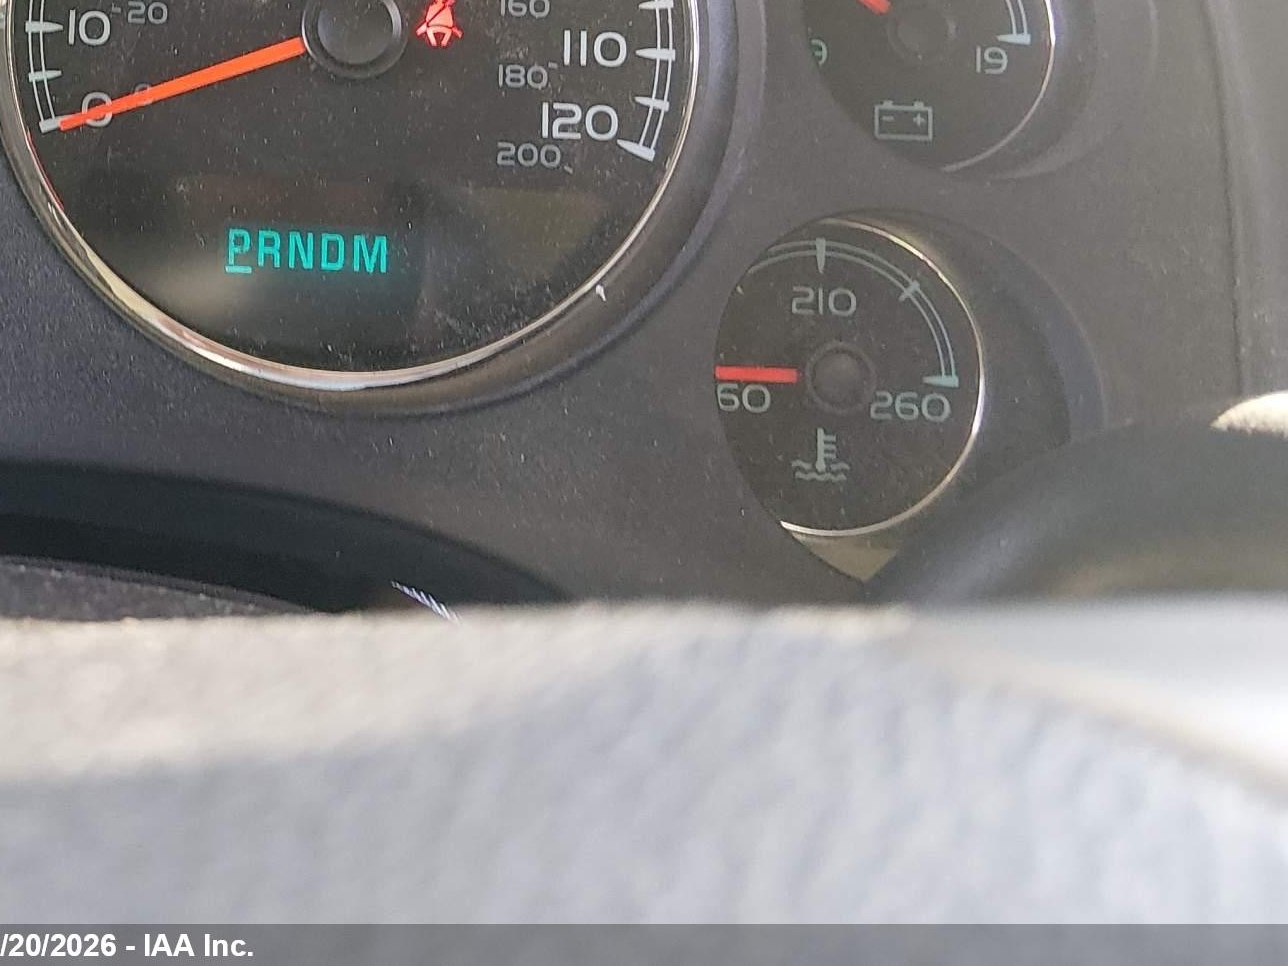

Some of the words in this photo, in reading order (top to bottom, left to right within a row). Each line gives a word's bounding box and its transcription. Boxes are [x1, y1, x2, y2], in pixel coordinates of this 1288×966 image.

[68, 9, 111, 46] 10
[127, 0, 168, 25] 20
[563, 30, 627, 67] 110
[976, 46, 1009, 74] 19
[498, 63, 548, 91] 180
[81, 91, 113, 127] 0
[541, 102, 619, 141] 120
[496, 142, 561, 168] 200
[791, 286, 857, 317] 210
[870, 391, 951, 422] 260
